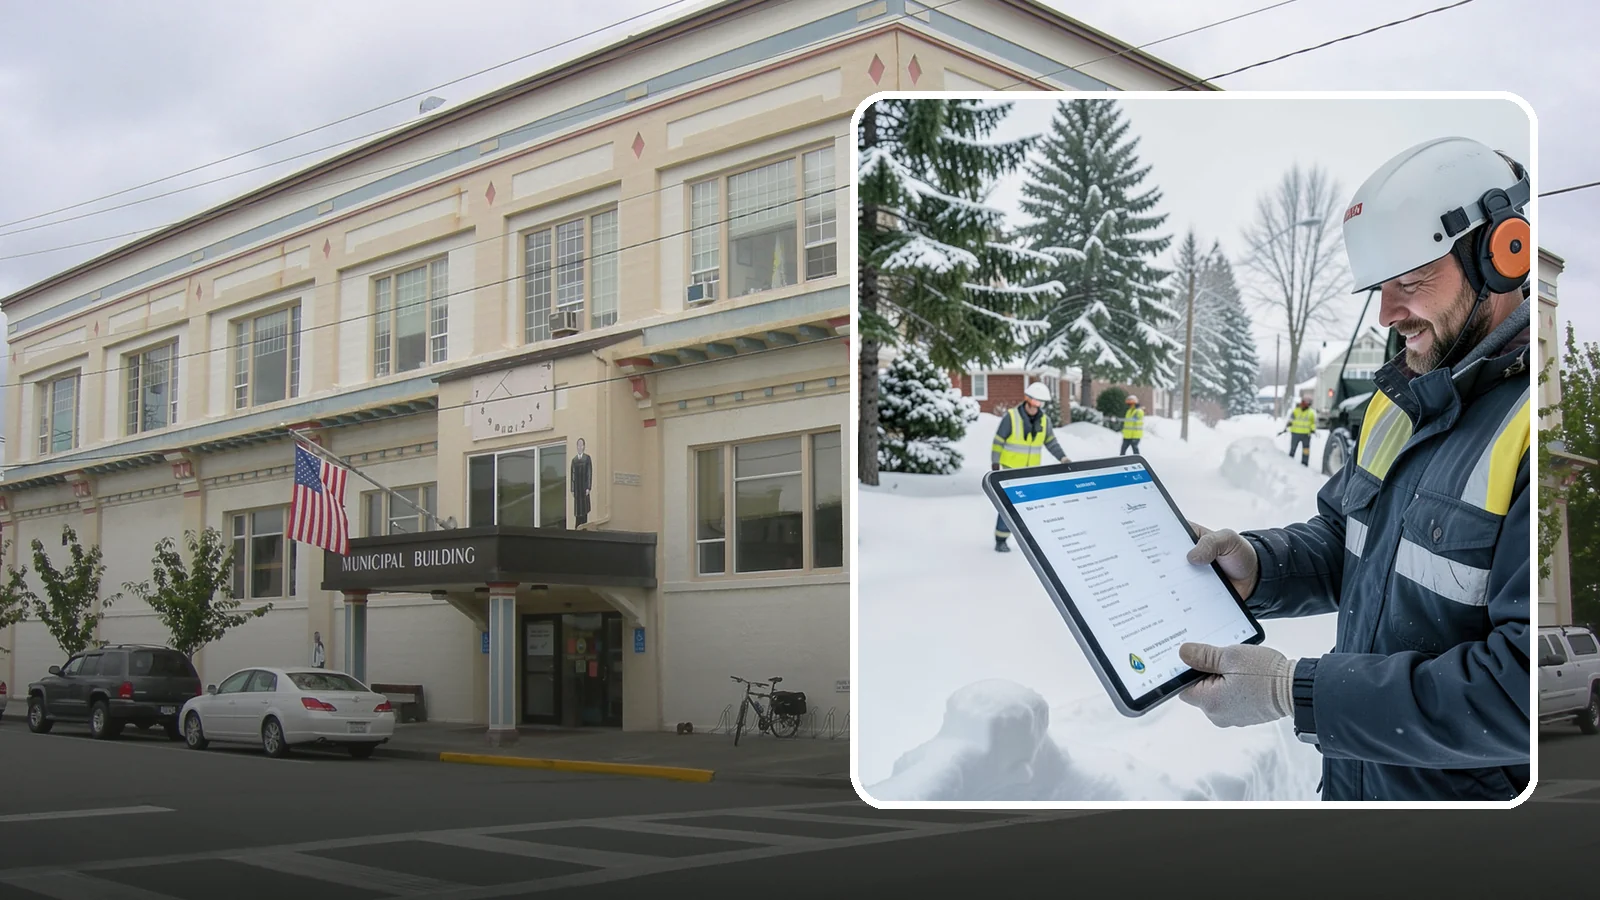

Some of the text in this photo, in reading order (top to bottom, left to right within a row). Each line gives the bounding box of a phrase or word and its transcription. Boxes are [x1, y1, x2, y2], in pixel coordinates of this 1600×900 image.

[494, 423, 500, 432] 10
[501, 425, 506, 434] 11
[507, 425, 513, 434] 12
[342, 546, 475, 572] MUNICIPAL BUILDING
